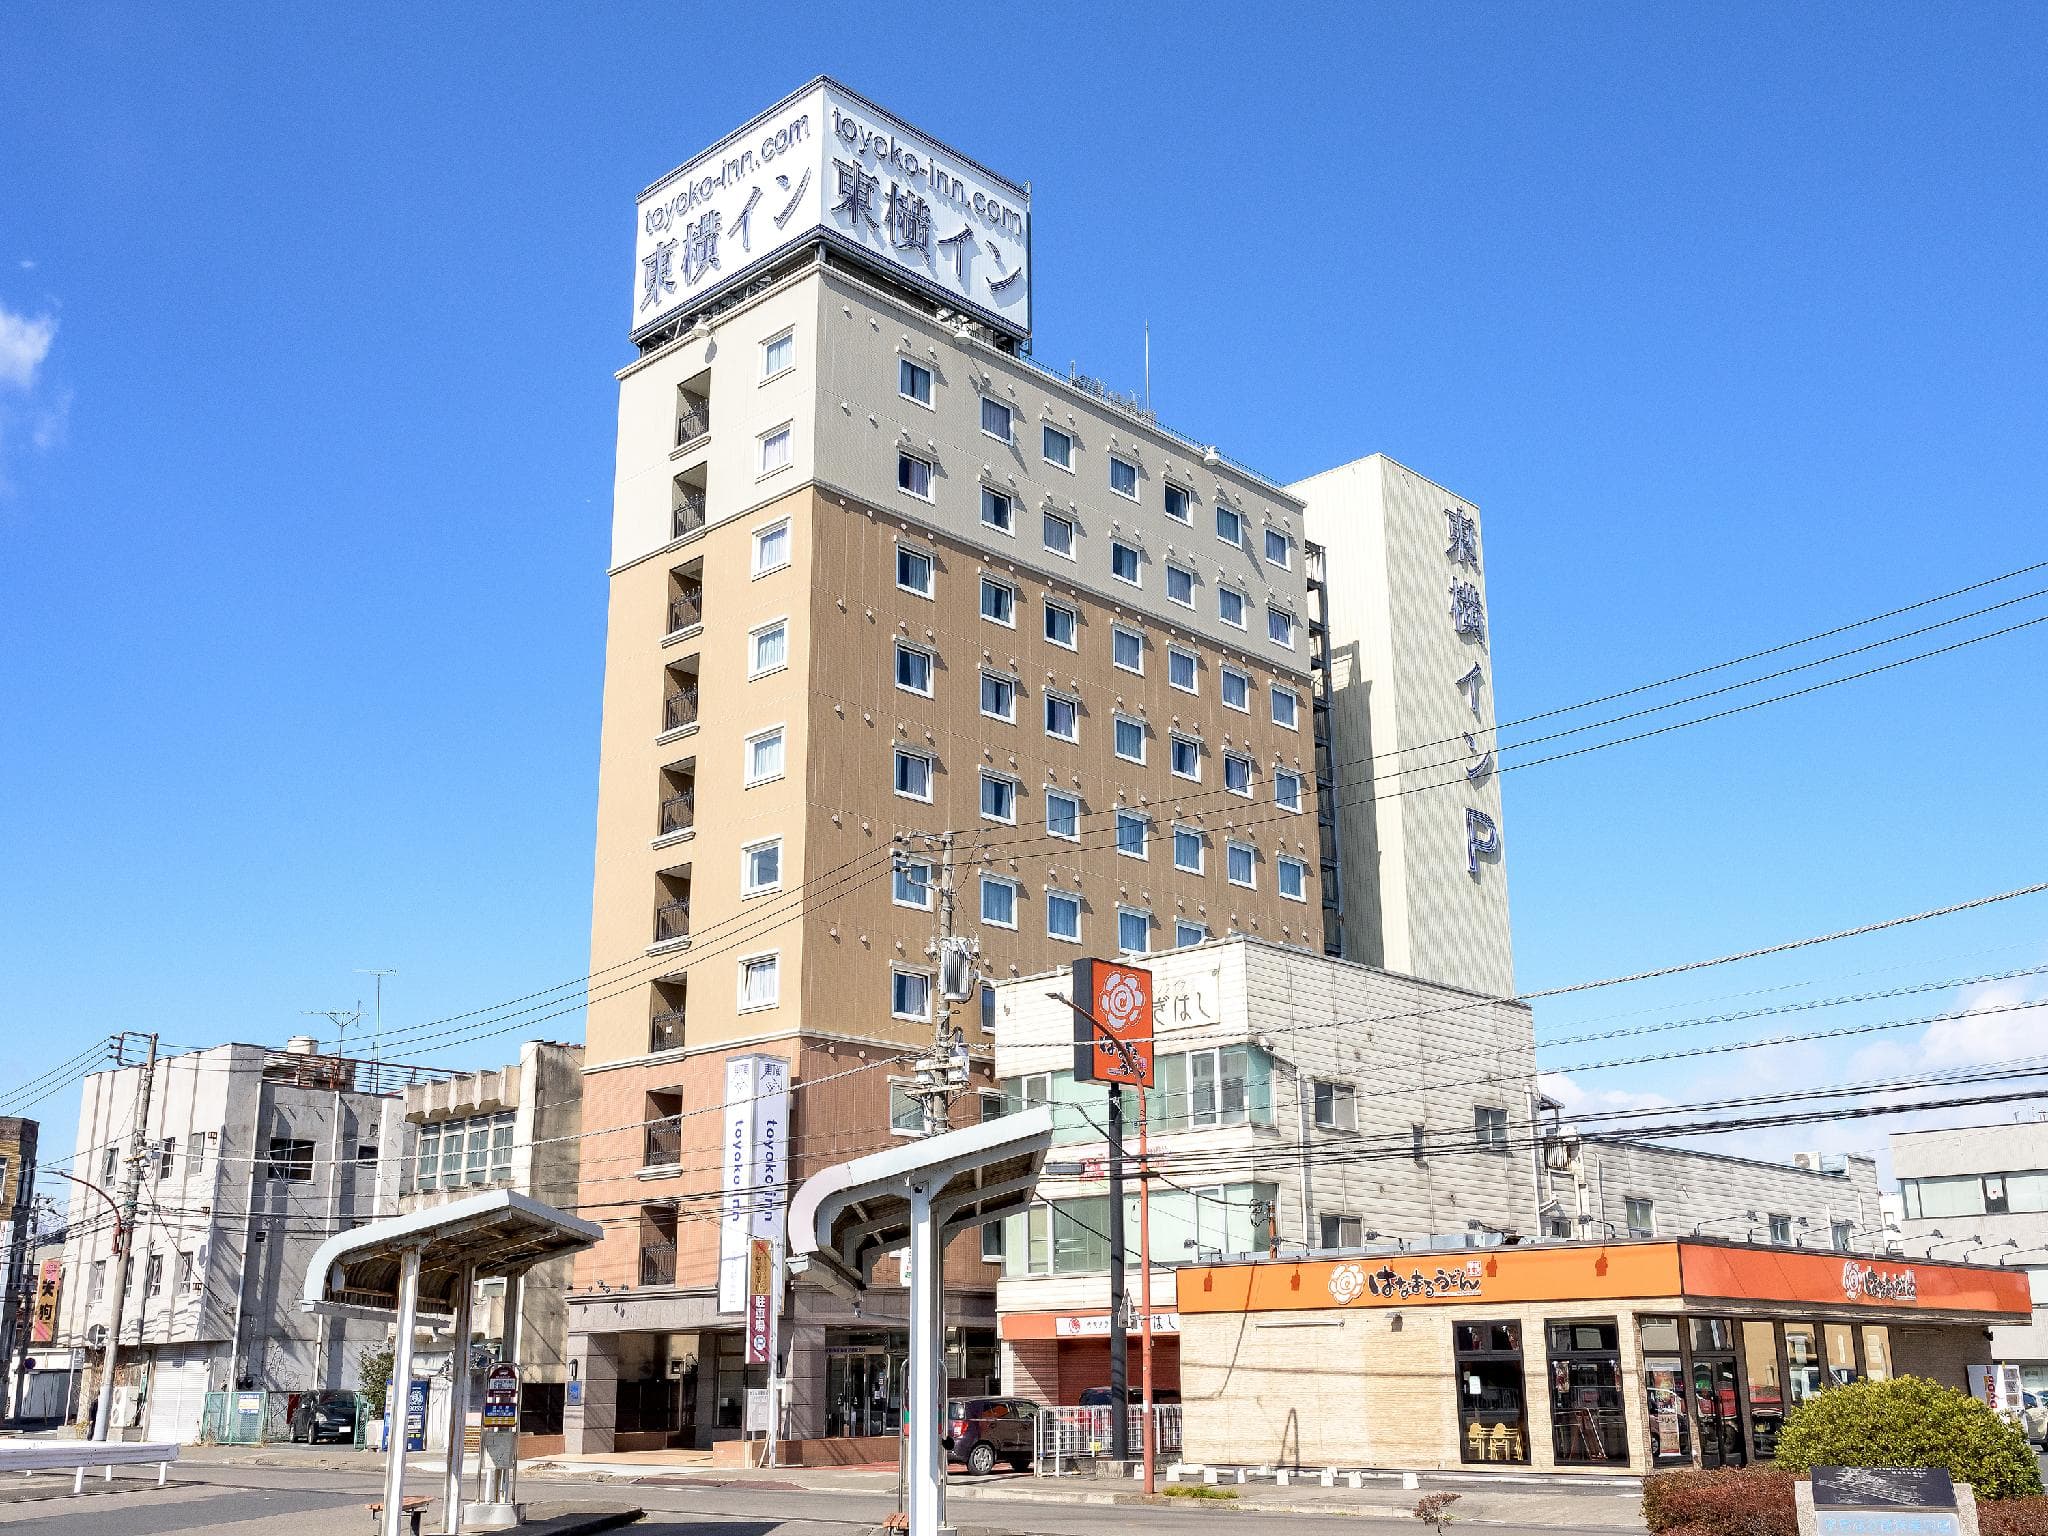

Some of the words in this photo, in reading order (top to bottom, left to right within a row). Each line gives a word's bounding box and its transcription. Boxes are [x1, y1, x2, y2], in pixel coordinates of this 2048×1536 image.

[643, 114, 811, 234] toyoko-inn.com
[831, 157, 1022, 294] 東横イン
[832, 107, 1022, 236] toyoko-inn.com
[640, 167, 812, 312] 東横イン
[1465, 806, 1497, 873] P
[763, 1119, 778, 1185] toyoko
[1368, 1264, 1480, 1298] はなまるうどん
